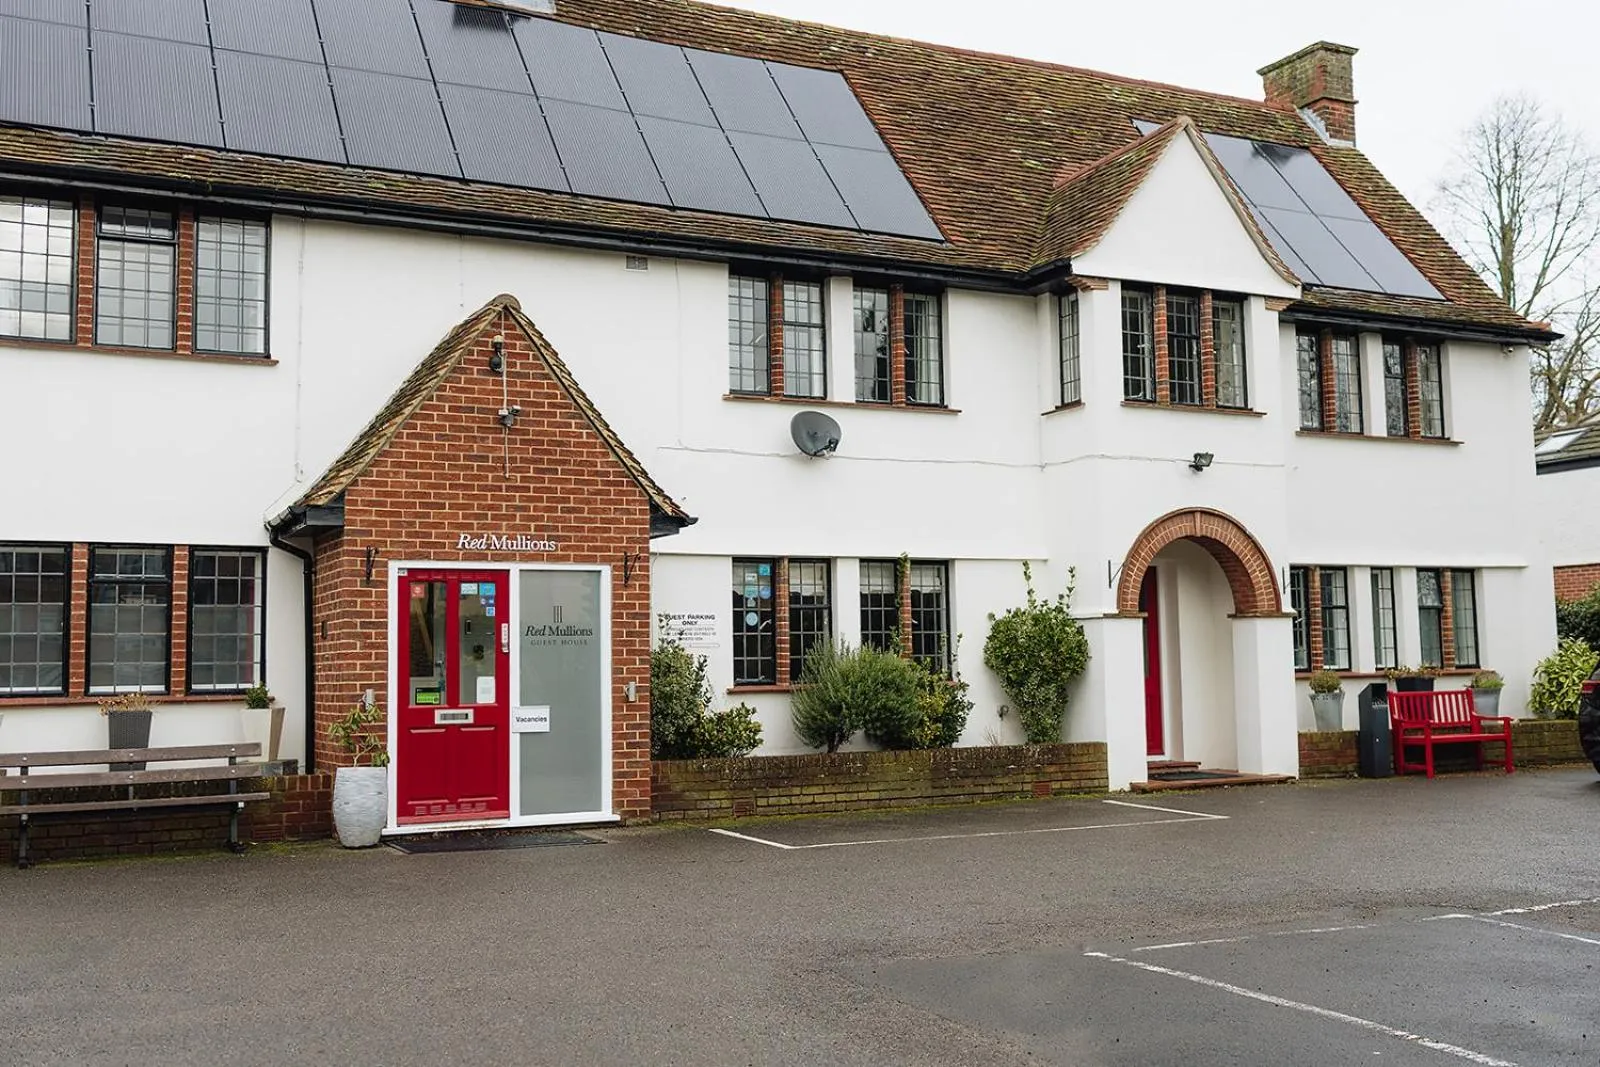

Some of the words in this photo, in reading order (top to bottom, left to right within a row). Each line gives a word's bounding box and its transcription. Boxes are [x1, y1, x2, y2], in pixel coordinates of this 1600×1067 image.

[456, 533, 488, 549] Red
[490, 534, 556, 550] Mullions
[525, 625, 546, 637] Red
[547, 625, 593, 637] Mullions
